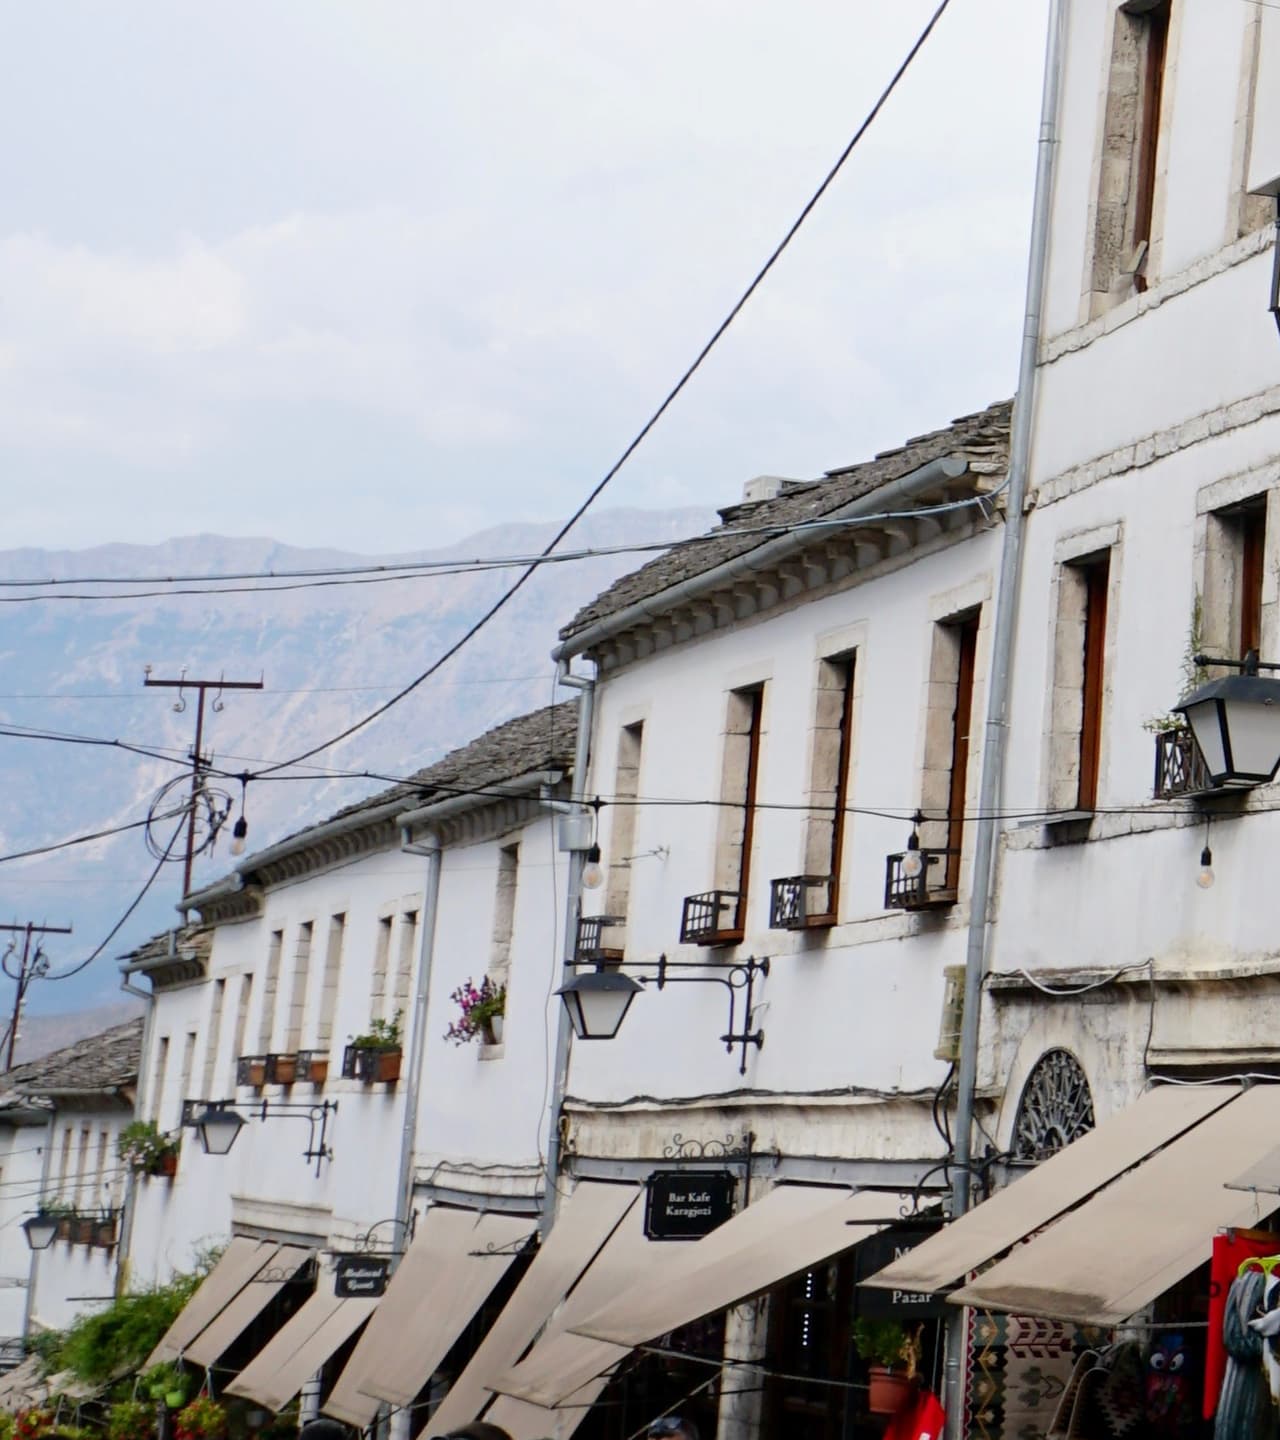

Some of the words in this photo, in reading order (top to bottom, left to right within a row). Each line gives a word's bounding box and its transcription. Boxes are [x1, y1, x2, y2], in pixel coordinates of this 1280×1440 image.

[668, 1192, 686, 1202] Bar
[688, 1191, 711, 1202] Kafe
[892, 1290, 933, 1304] Pazar
